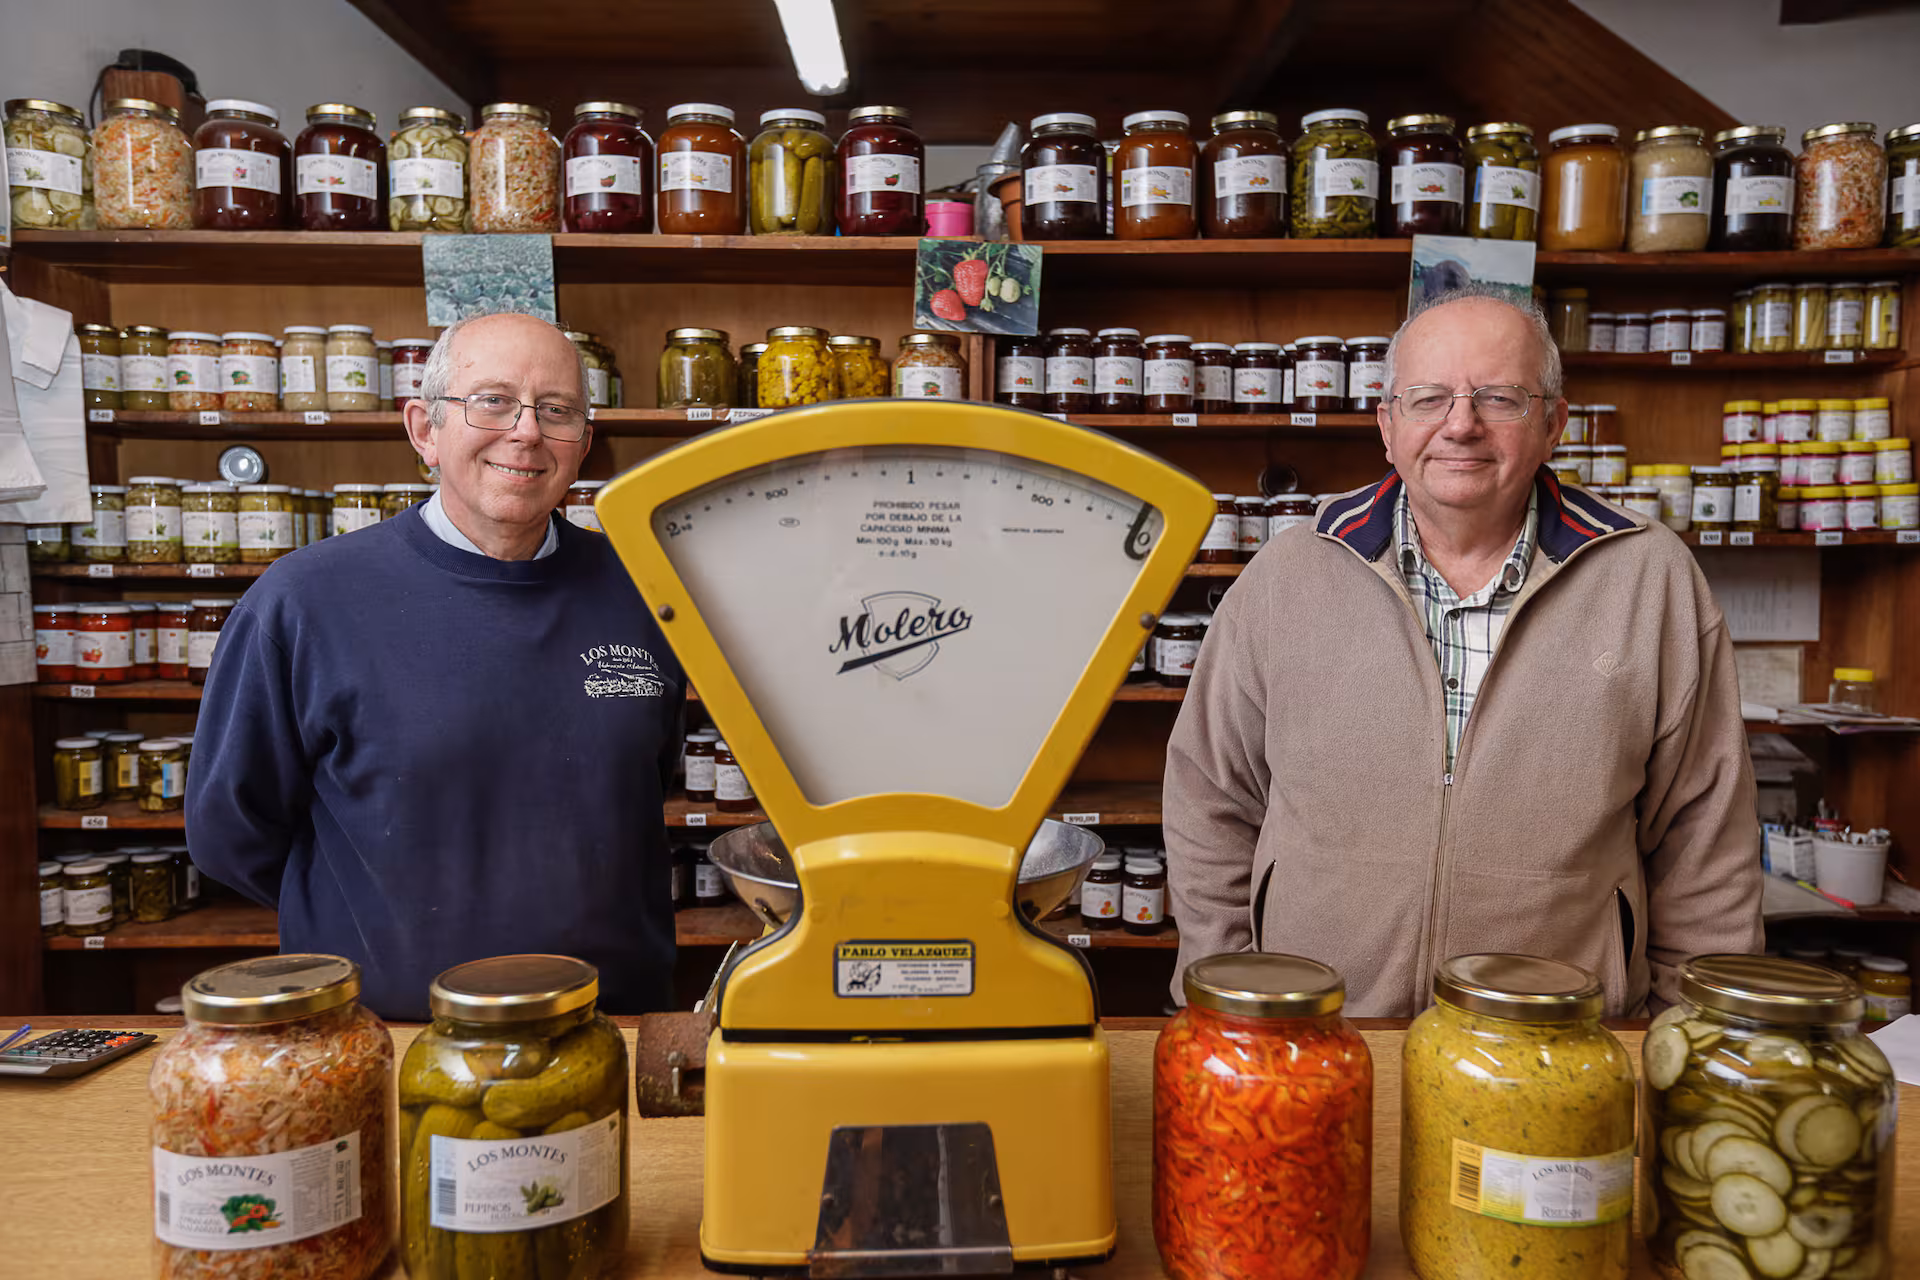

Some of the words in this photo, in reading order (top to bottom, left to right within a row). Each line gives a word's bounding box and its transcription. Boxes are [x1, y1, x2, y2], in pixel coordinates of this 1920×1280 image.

[690, 411, 711, 419] 1100
[1175, 415, 1190, 424] 980
[1294, 416, 1313, 424] 1500
[908, 469, 915, 484] 1
[765, 488, 788, 500] 500
[1031, 494, 1054, 506] 500
[873, 501, 925, 510] PROHIBIDO
[929, 502, 961, 511] PESAR
[865, 513, 886, 521] POR
[889, 513, 928, 522] DEBAJO
[931, 514, 945, 522] DE
[949, 514, 962, 522] LA
[665, 521, 681, 538] 2
[860, 524, 913, 533] CAPACIDAD
[829, 606, 973, 654] Molero
[580, 645, 608, 666] LOS
[609, 644, 659, 672] MONTES
[88, 817, 104, 825] 450
[689, 816, 704, 824] 400
[1069, 815, 1096, 824] 890,00
[1070, 937, 1087, 946] 520
[842, 947, 887, 957] PABLO
[891, 947, 969, 957] VELAZQUEZ
[467, 1150, 498, 1172] LOS
[501, 1143, 568, 1165] MONTES
[177, 1166, 204, 1186] LOS
[206, 1163, 277, 1186] MONTES
[1532, 1167, 1554, 1180] LOS
[1555, 1163, 1593, 1183] MONTES
[464, 1201, 512, 1213] PEPINOS
